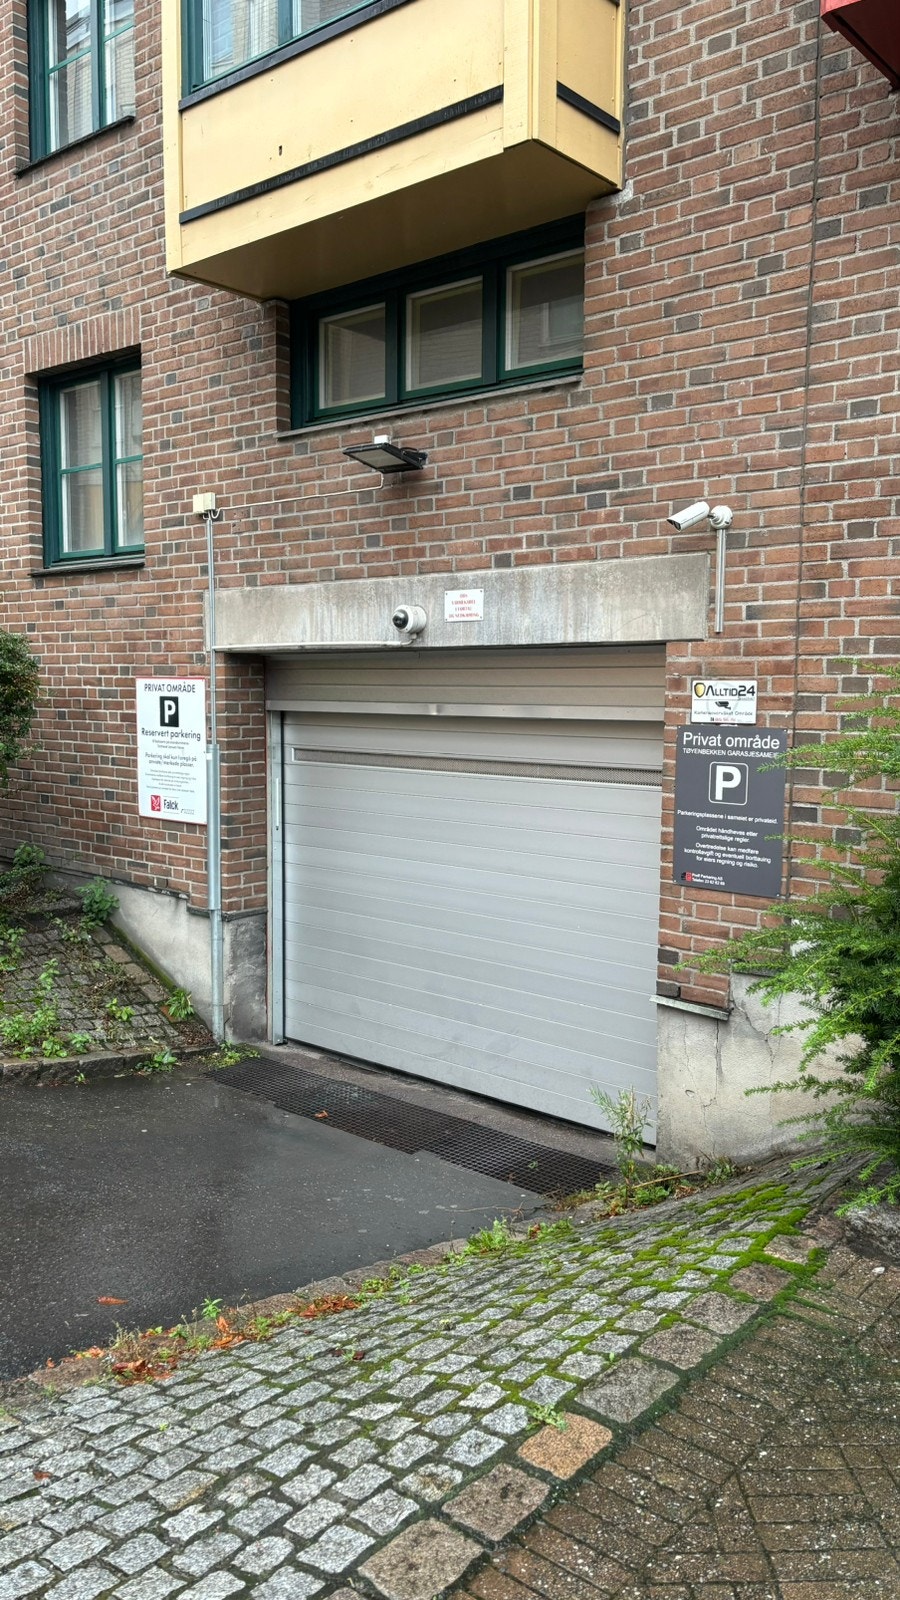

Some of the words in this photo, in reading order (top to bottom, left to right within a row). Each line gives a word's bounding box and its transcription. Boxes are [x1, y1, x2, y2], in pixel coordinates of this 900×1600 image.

[144, 683, 165, 692] PRIVAT
[166, 681, 196, 693] OMRÅDE
[164, 700, 176, 723] P
[141, 727, 169, 737] Reservert
[170, 729, 201, 742] parkering
[683, 731, 722, 747] Privat
[725, 734, 780, 749] område
[682, 748, 727, 756] TØYENBEKKEN
[715, 765, 742, 800] P
[164, 799, 179, 810] Falck
[677, 809, 724, 819] Parkeringsplassene
[718, 828, 745, 836] håndheves
[695, 842, 726, 851] Overtredelse
